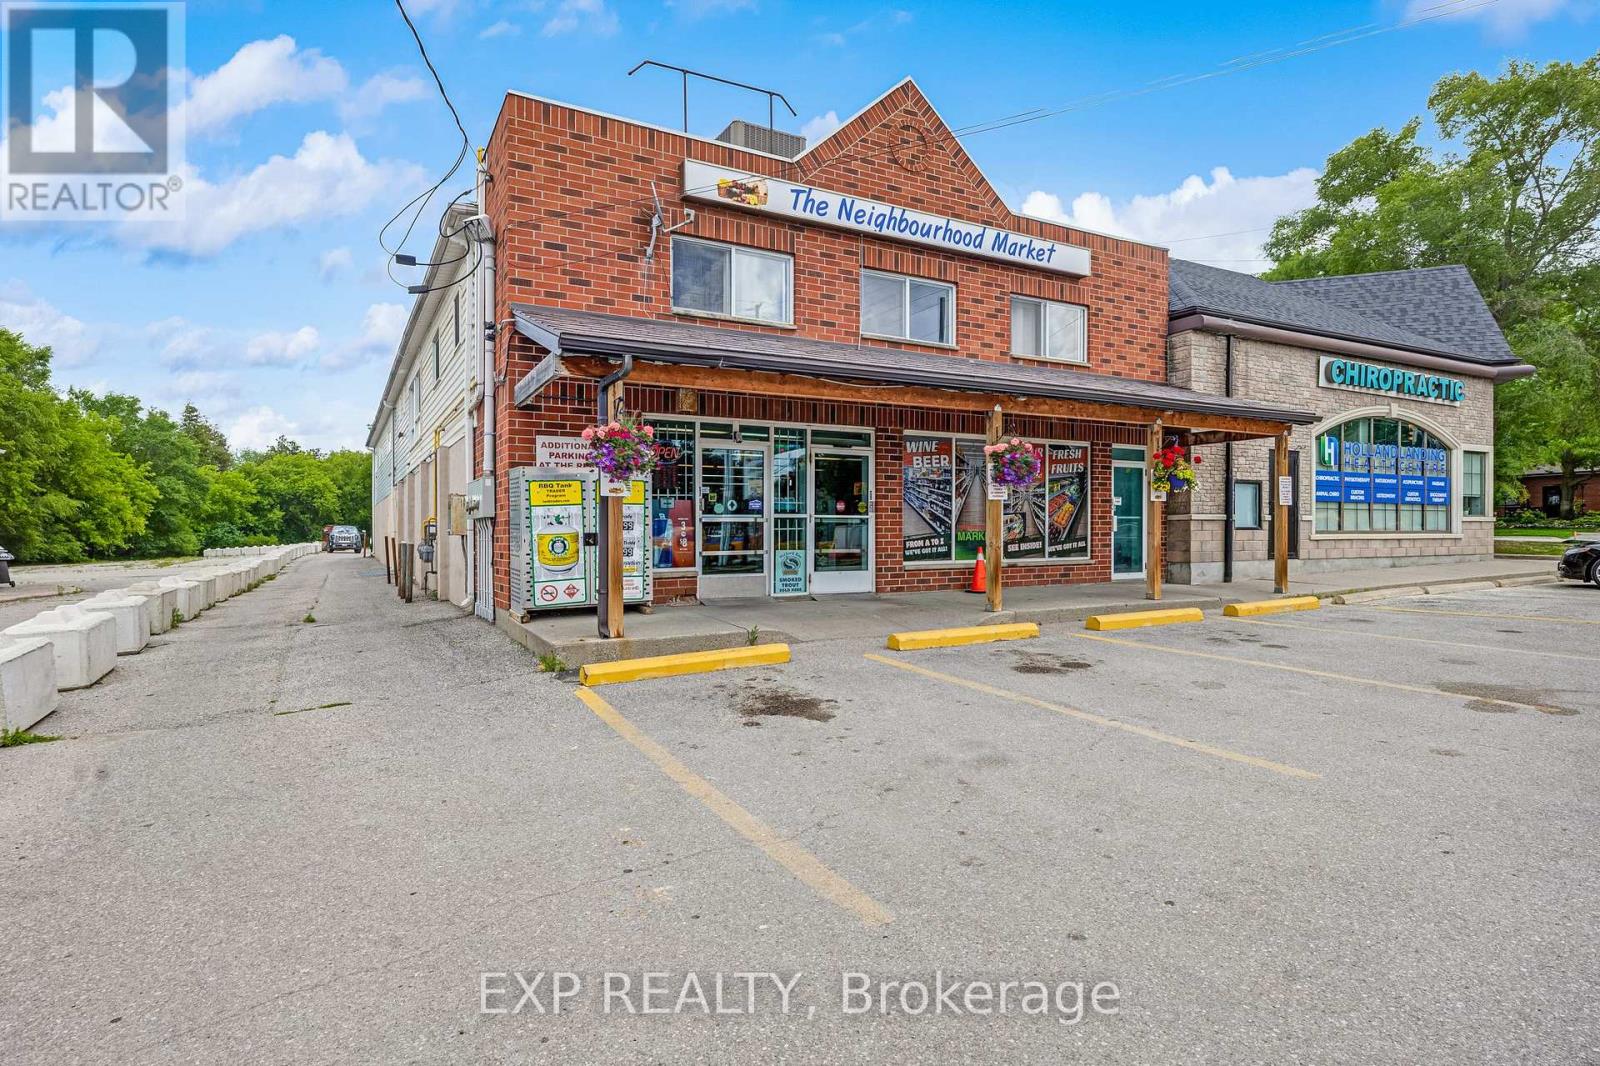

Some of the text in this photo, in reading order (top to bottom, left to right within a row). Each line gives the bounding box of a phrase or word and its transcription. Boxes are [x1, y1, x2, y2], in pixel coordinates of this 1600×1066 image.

[790, 187, 1057, 264] The Neighbourhood Market
[1327, 358, 1466, 402] CHIROPRACTIC
[540, 441, 594, 450] ADDITIONA
[651, 444, 680, 459] OPEN
[905, 440, 939, 453] WINE
[1344, 440, 1447, 462] HOLLAND LANDING
[548, 451, 593, 460] PARKING
[1052, 449, 1083, 460] FRESH
[912, 454, 950, 469] BEER
[1344, 457, 1446, 474] HEALTH CENTRE
[1050, 462, 1085, 474] FRUITS
[957, 531, 986, 542] MARK
[905, 540, 924, 549] FROM
[925, 539, 931, 547] A
[931, 538, 940, 546] TO
[1007, 541, 1042, 552] SEE INSIDE!
